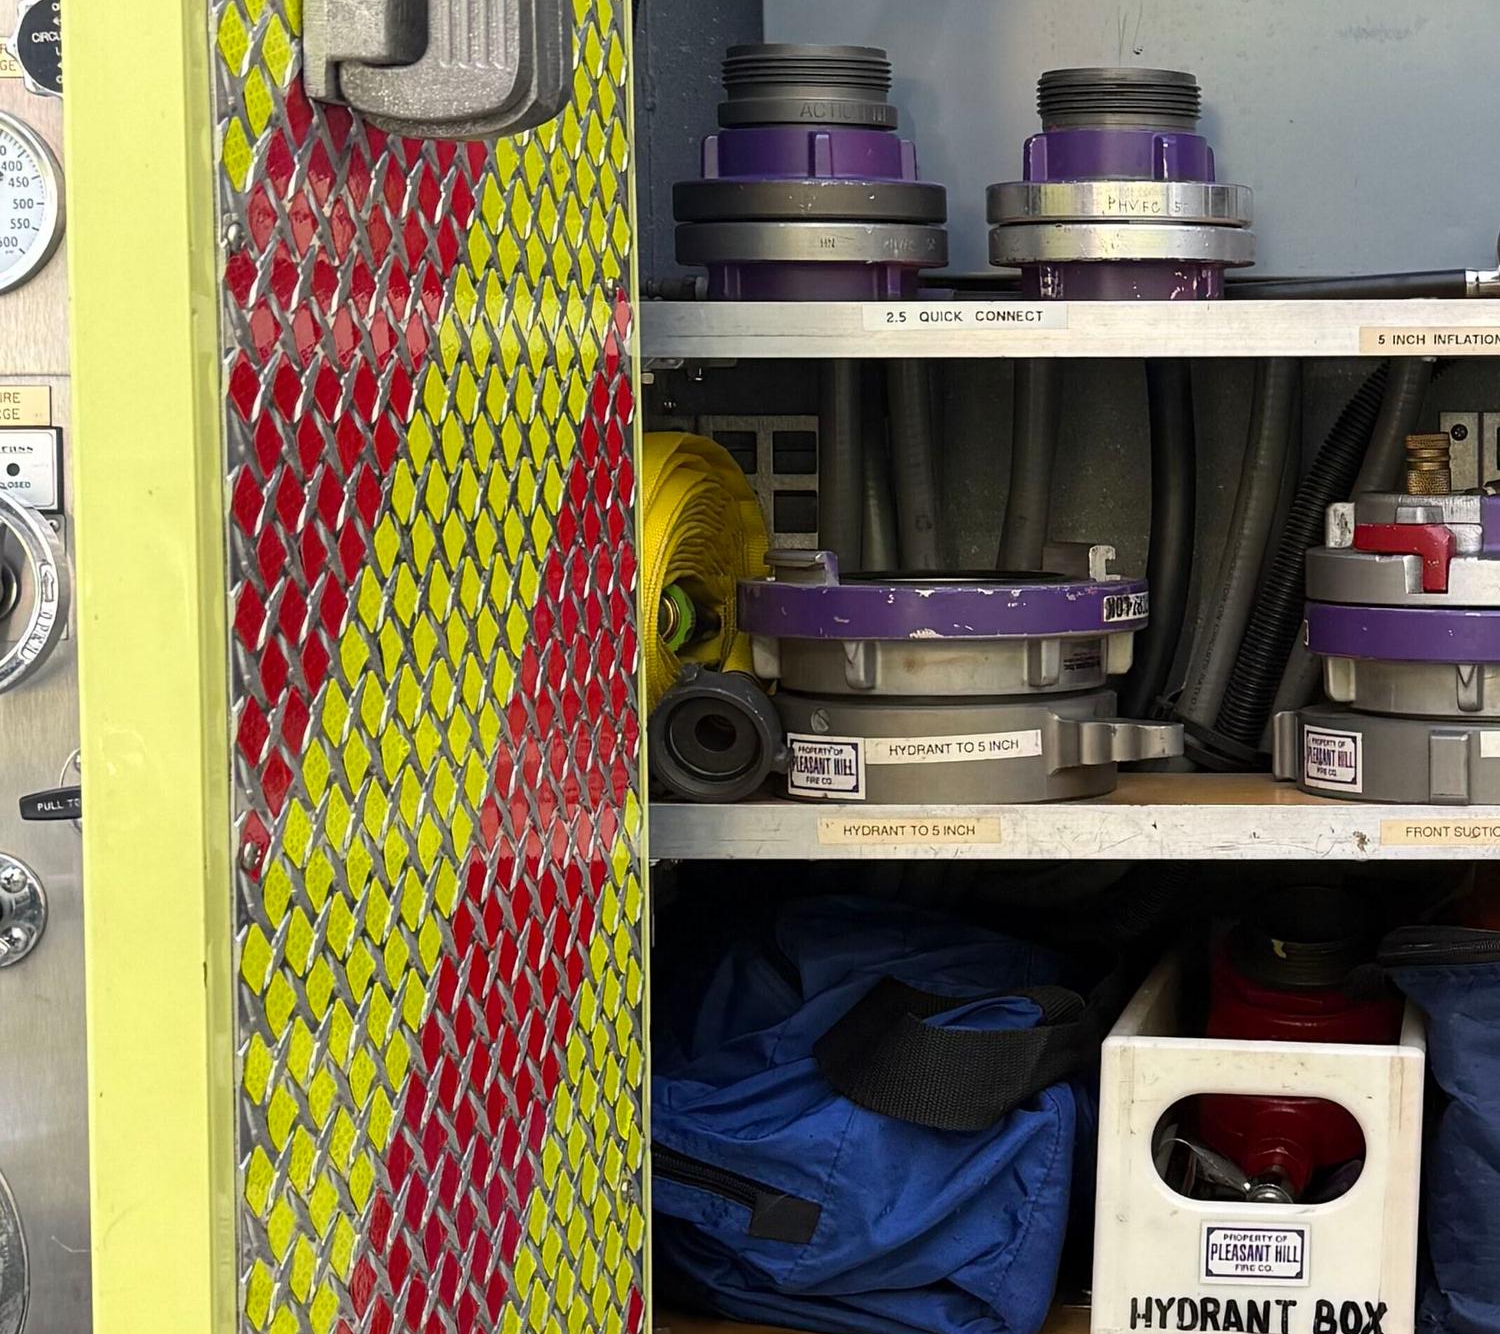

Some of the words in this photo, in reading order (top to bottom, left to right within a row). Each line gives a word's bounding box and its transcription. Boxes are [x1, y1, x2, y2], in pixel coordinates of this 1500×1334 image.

[8, 176, 30, 188] 450
[13, 198, 34, 210] 500
[10, 218, 31, 230] 550
[886, 311, 907, 323] 2.5
[918, 310, 963, 323] QUICK
[974, 310, 1044, 322] CONNECT
[1377, 334, 1386, 345] 5
[1392, 334, 1426, 345] INCH
[798, 745, 832, 755] PROPERTY
[889, 743, 952, 756] HYDRANT
[956, 741, 974, 754] TO
[978, 740, 986, 752] 5
[989, 739, 1019, 751] INCH
[1338, 750, 1353, 768] HILL
[792, 755, 830, 775] PLEASANT
[833, 757, 856, 776] HILL
[805, 776, 820, 785] FIRE
[37, 799, 64, 812] PULL
[843, 824, 907, 837] HYDRANT
[910, 824, 929, 836] TO
[932, 824, 940, 836] 5
[943, 824, 976, 836] INCH
[1405, 826, 1451, 838] FRONT
[1223, 1233, 1273, 1243] PROPERTY
[1275, 1234, 1288, 1243] OF
[1210, 1243, 1272, 1262] PLEASANT
[1274, 1245, 1300, 1263] HILL
[1234, 1263, 1256, 1272] FIRE
